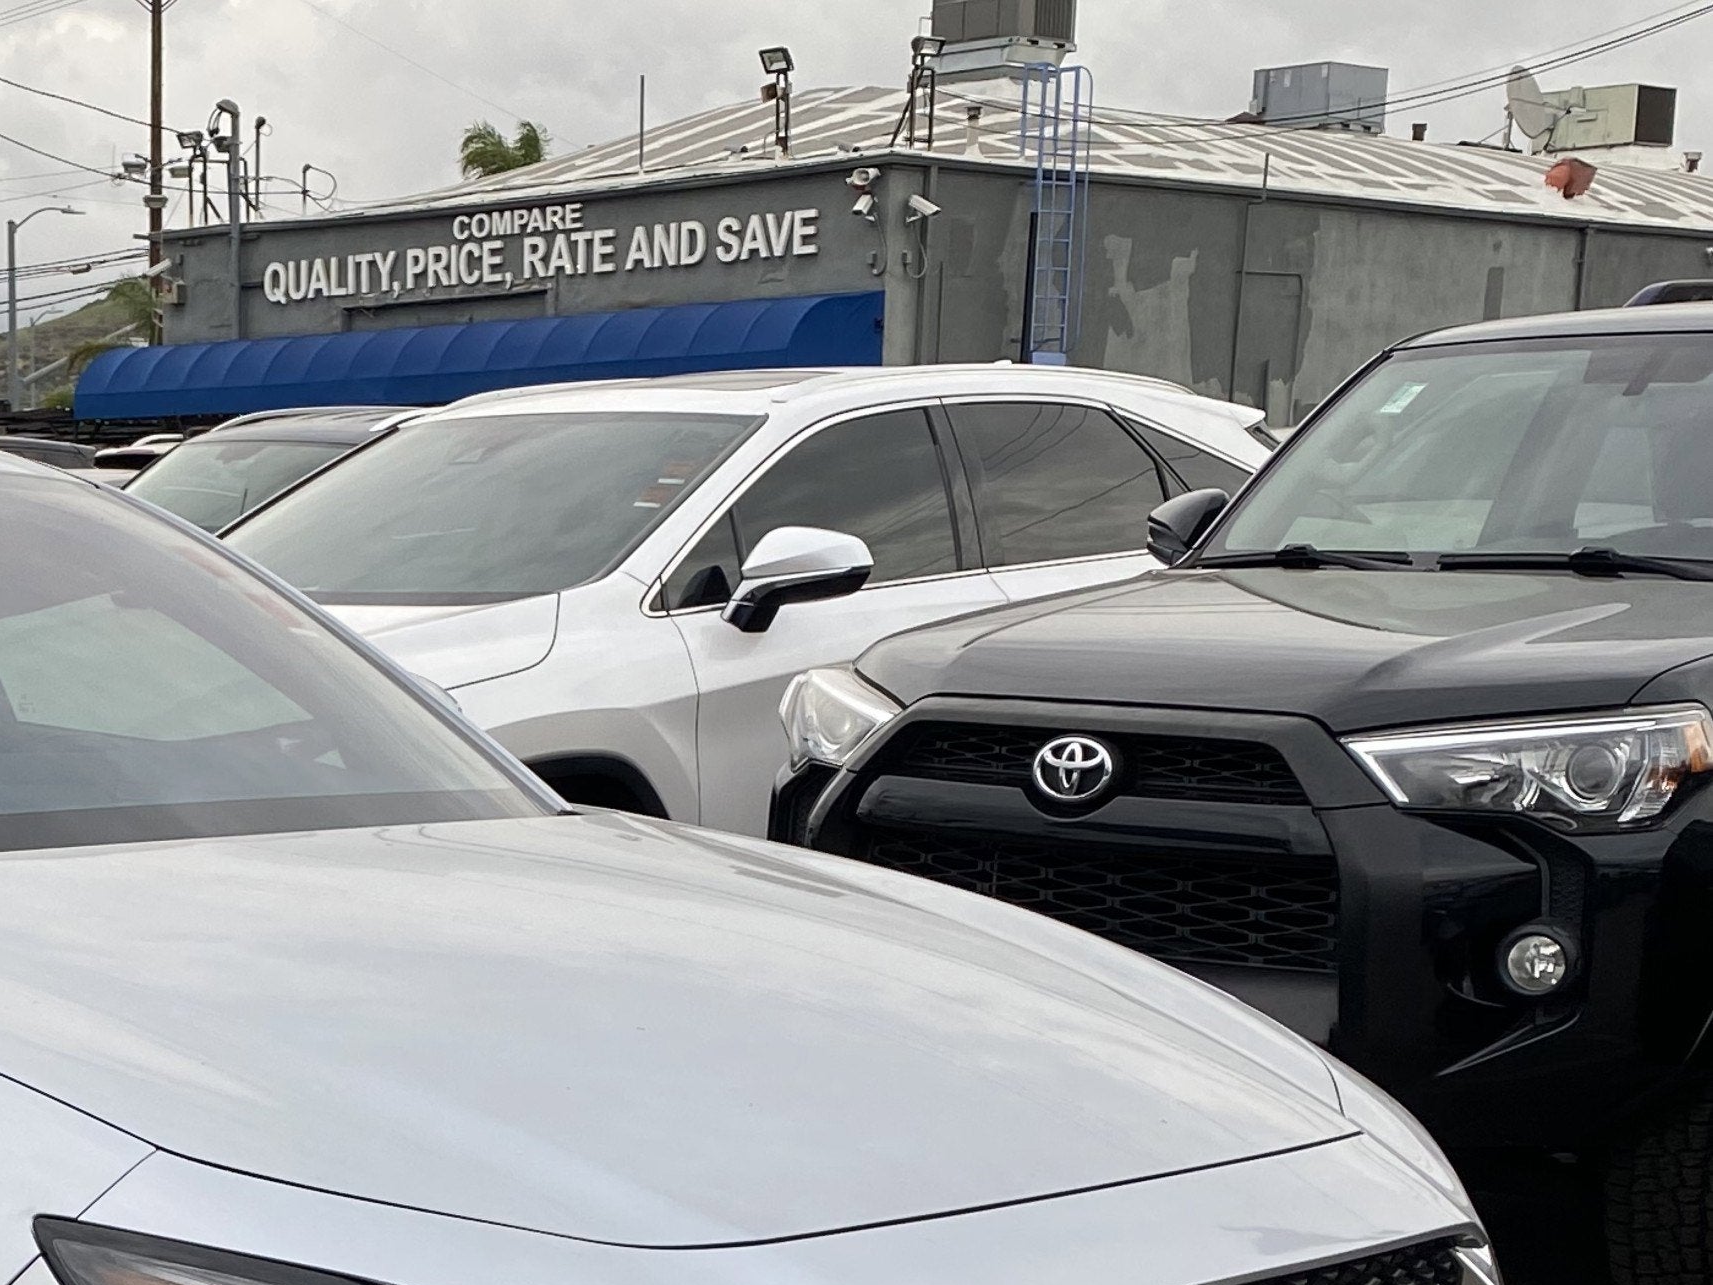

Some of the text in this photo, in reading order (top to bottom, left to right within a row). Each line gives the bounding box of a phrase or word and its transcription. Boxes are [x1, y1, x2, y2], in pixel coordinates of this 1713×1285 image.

[452, 203, 584, 241] COMPARE
[263, 208, 820, 303] QUALITY, PRICE, RATE AND SAVE
